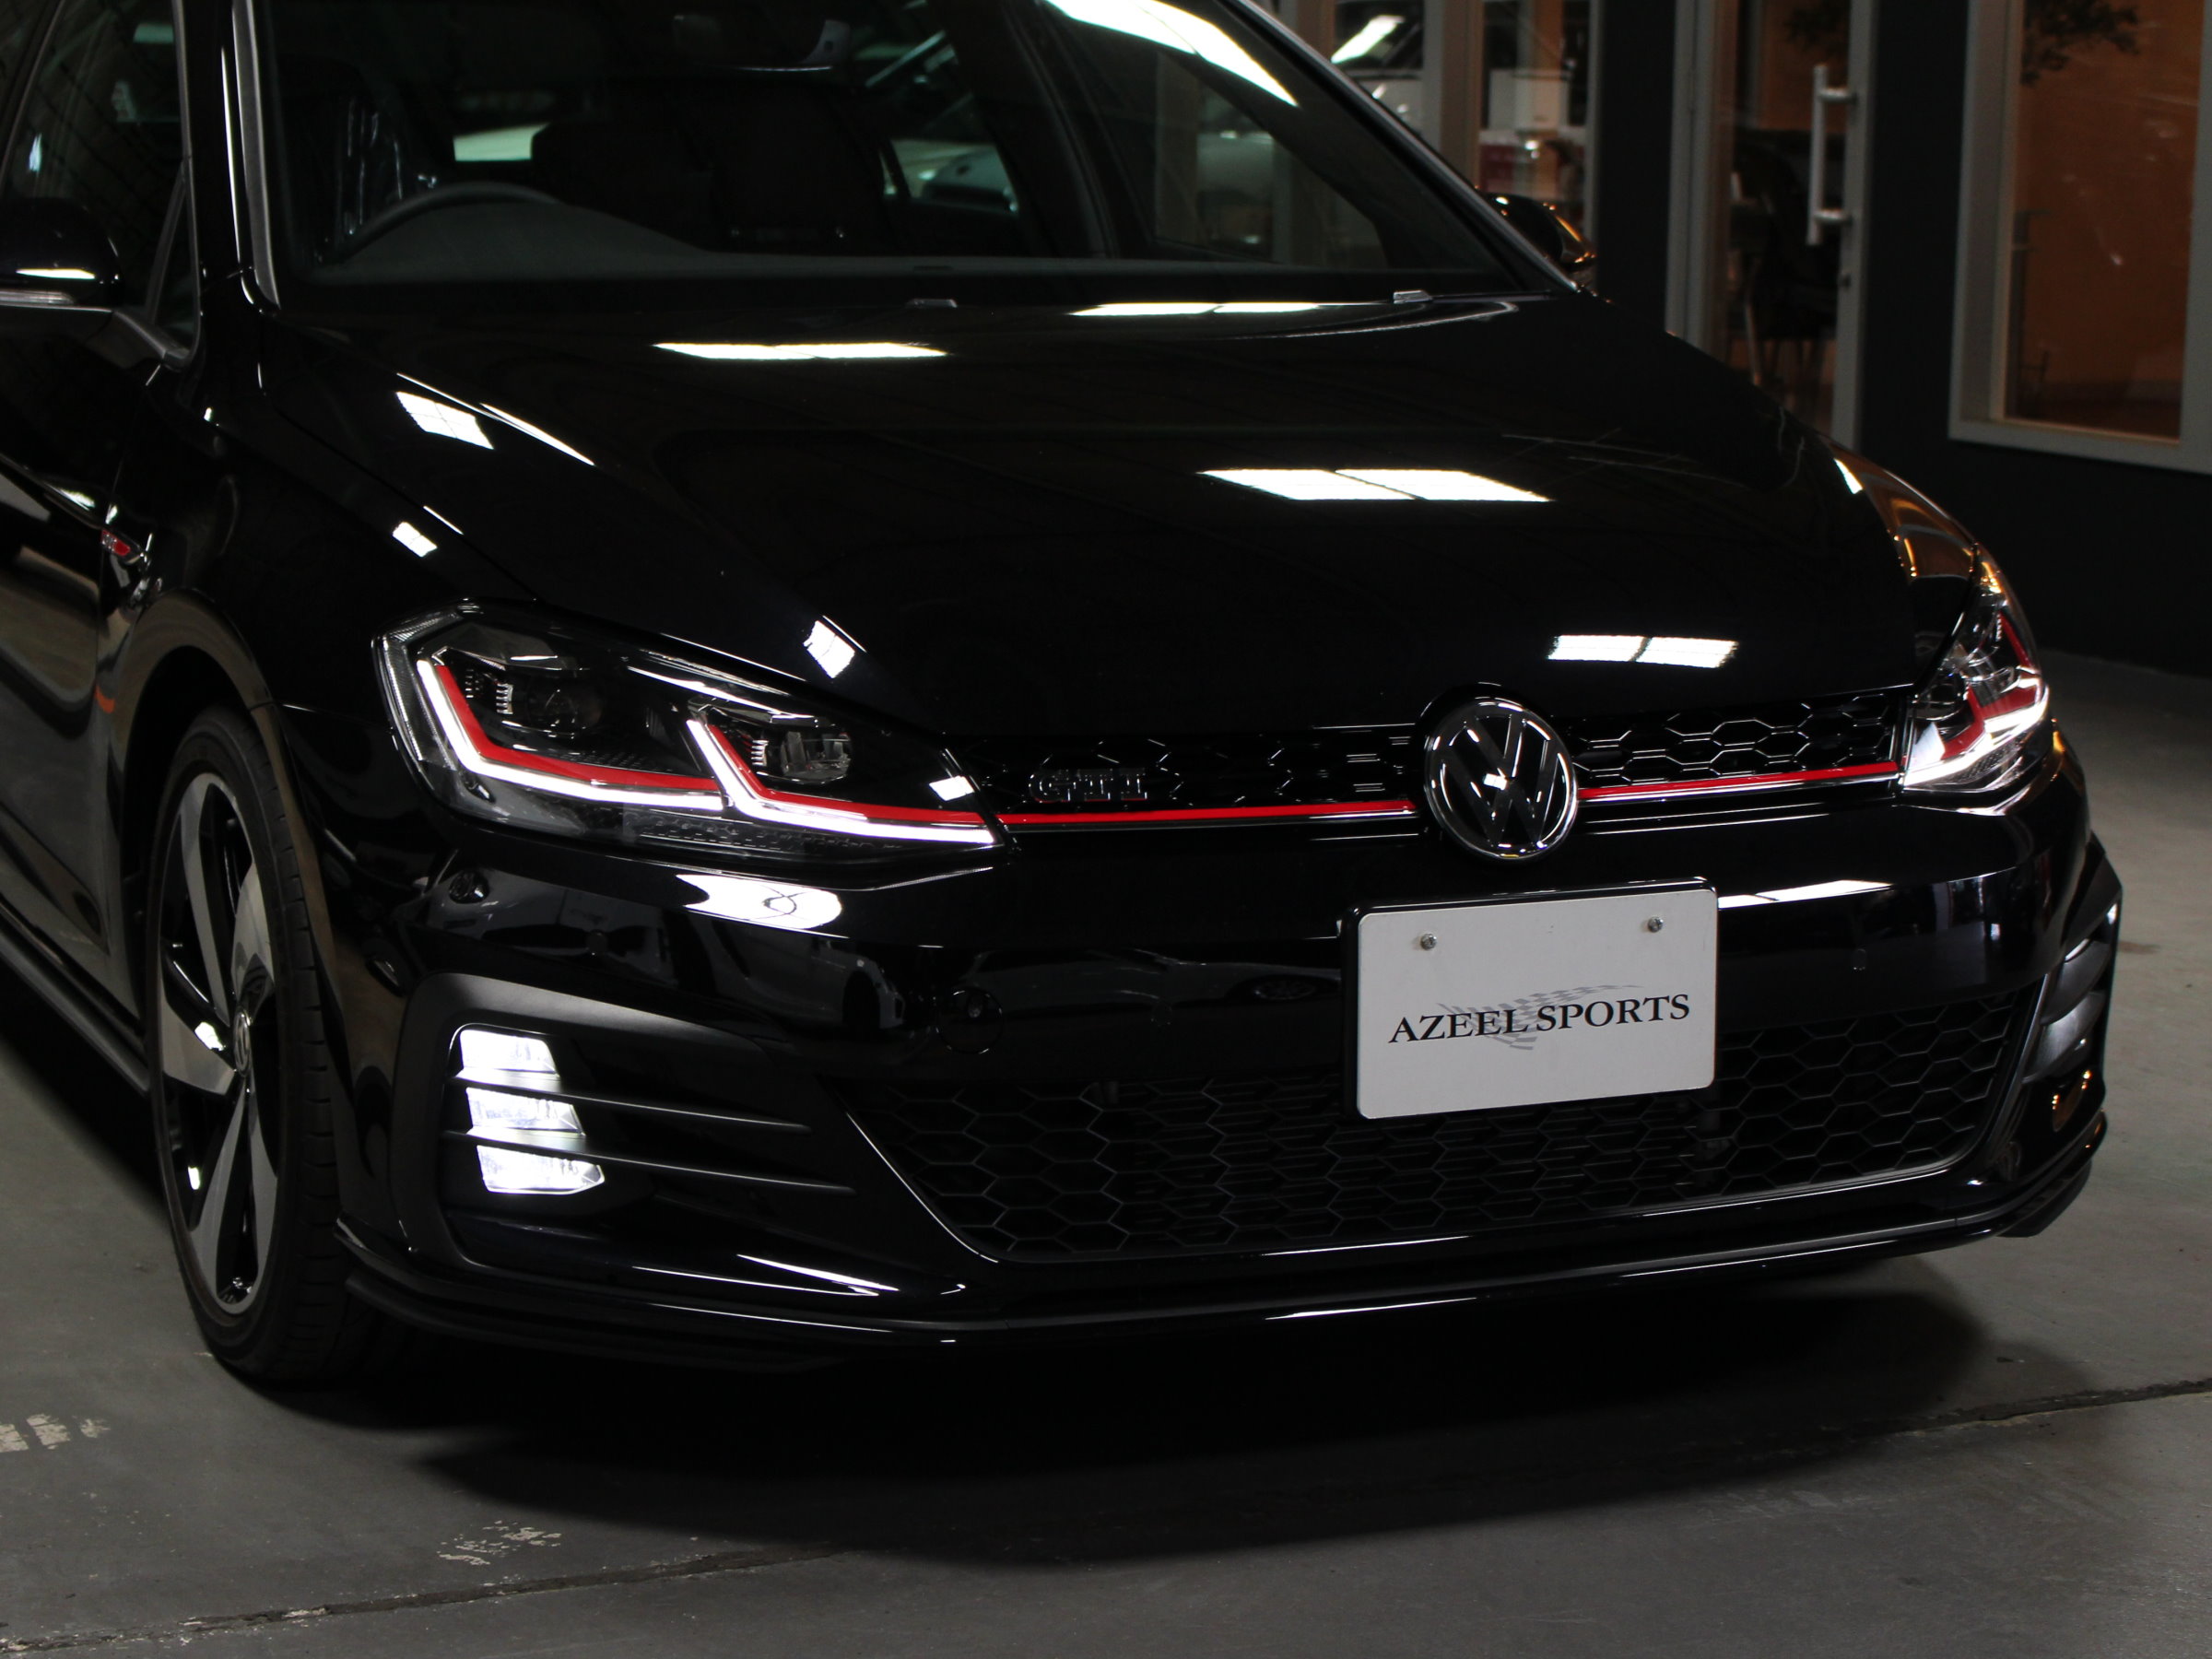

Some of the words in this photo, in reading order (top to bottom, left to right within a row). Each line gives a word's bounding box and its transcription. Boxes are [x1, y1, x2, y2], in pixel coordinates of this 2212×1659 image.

[1029, 768, 1148, 804] GTI
[1388, 1008, 1529, 1044] AZEEL
[1535, 993, 1690, 1032] SPORTS
